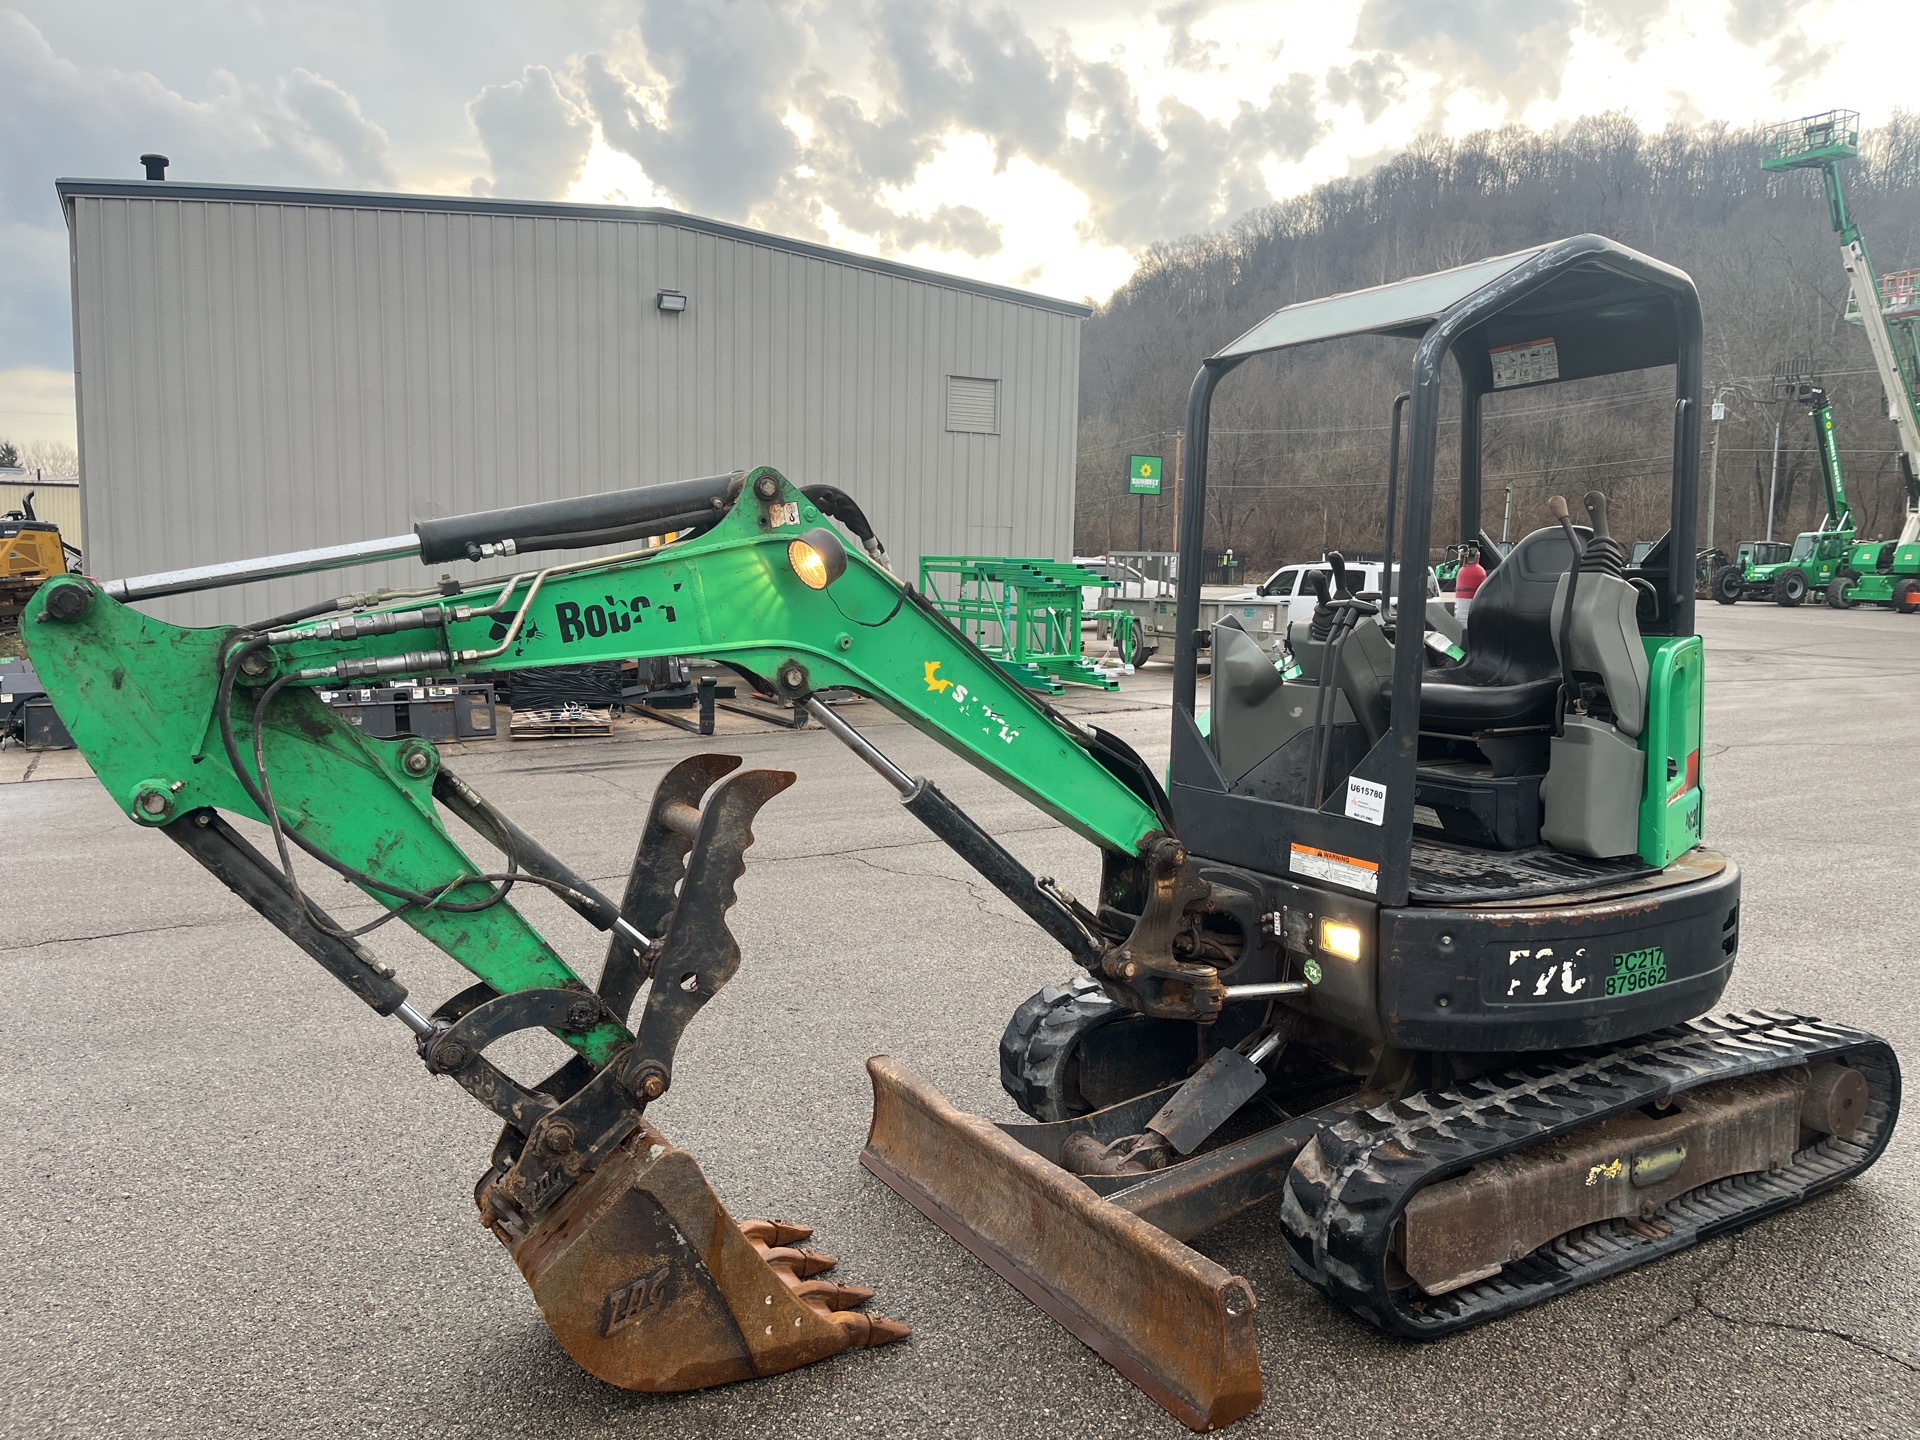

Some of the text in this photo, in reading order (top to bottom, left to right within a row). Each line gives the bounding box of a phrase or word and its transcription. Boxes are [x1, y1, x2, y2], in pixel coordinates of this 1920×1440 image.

[1131, 478, 1159, 486] SUNBELT
[1350, 784, 1383, 800] U615780
[1324, 851, 1350, 864] WARNING
[1309, 966, 1317, 978] T4
[1605, 966, 1667, 997] 879662
